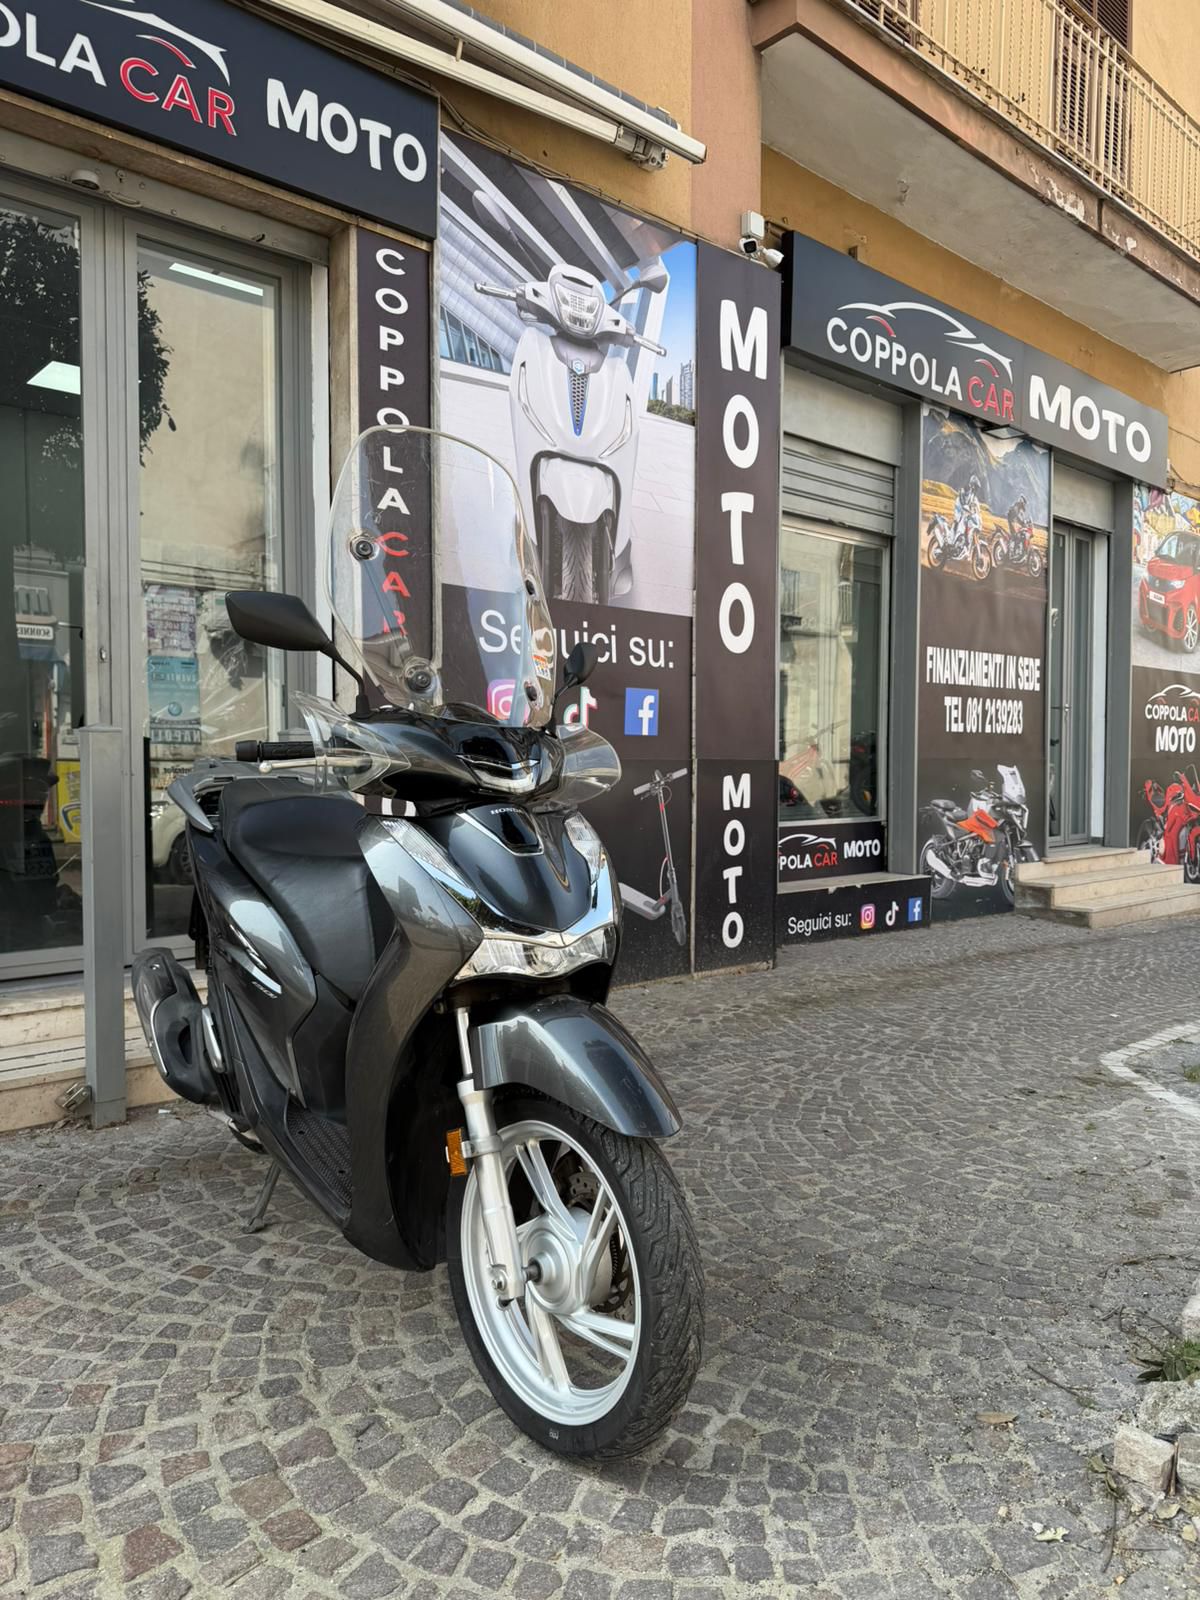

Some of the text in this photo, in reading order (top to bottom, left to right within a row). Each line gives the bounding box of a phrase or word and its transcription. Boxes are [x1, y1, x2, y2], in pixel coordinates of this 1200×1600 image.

[119, 57, 238, 136] CAR
[266, 78, 427, 183] MOTO
[826, 316, 1152, 463] COPPOLA CAR MOTO
[719, 299, 769, 655] MOTO
[629, 636, 674, 669] su:
[926, 645, 1041, 692] FINANZIAMENTI IN SEDE
[943, 695, 1025, 735] TEL 081 2139283
[1144, 703, 1188, 722] COPPOLA
[1155, 724, 1197, 754] MOTO
[722, 772, 751, 949] MOTO
[813, 851, 839, 869] CAR
[843, 838, 881, 859] MOTO
[787, 912, 852, 937] Seguici su:
